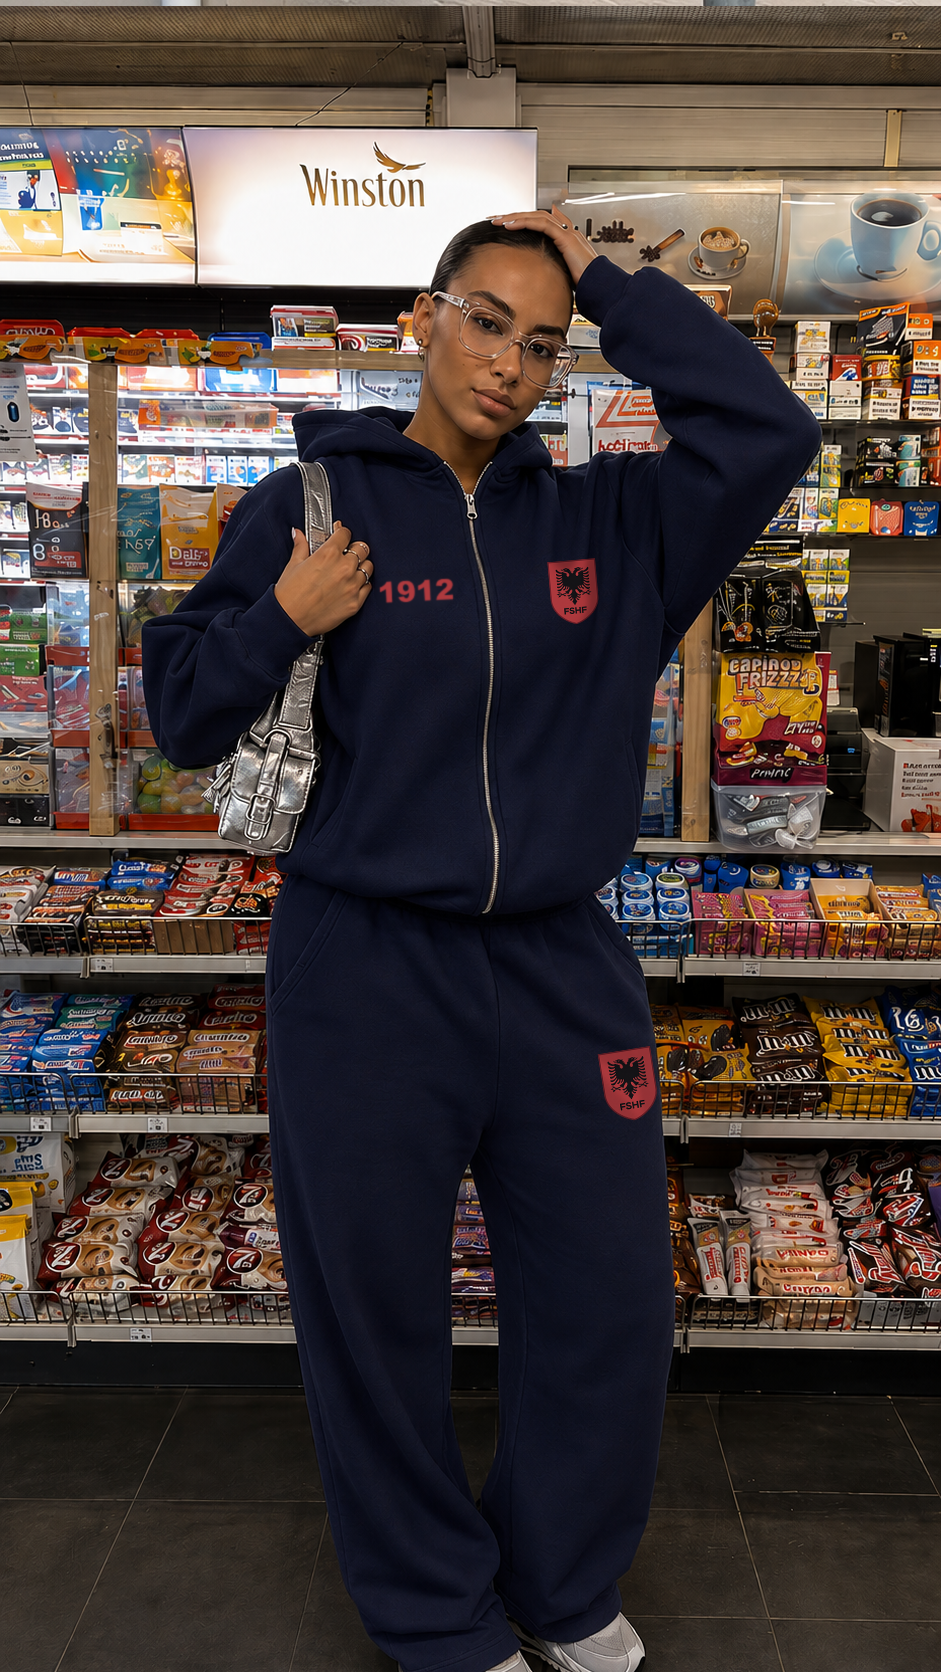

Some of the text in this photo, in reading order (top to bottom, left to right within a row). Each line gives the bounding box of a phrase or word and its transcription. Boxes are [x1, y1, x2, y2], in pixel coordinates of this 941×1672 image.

[299, 164, 425, 207] Winston
[379, 578, 454, 603] 1912
[563, 605, 588, 615] FSHF
[619, 1100, 645, 1111] FSHF
